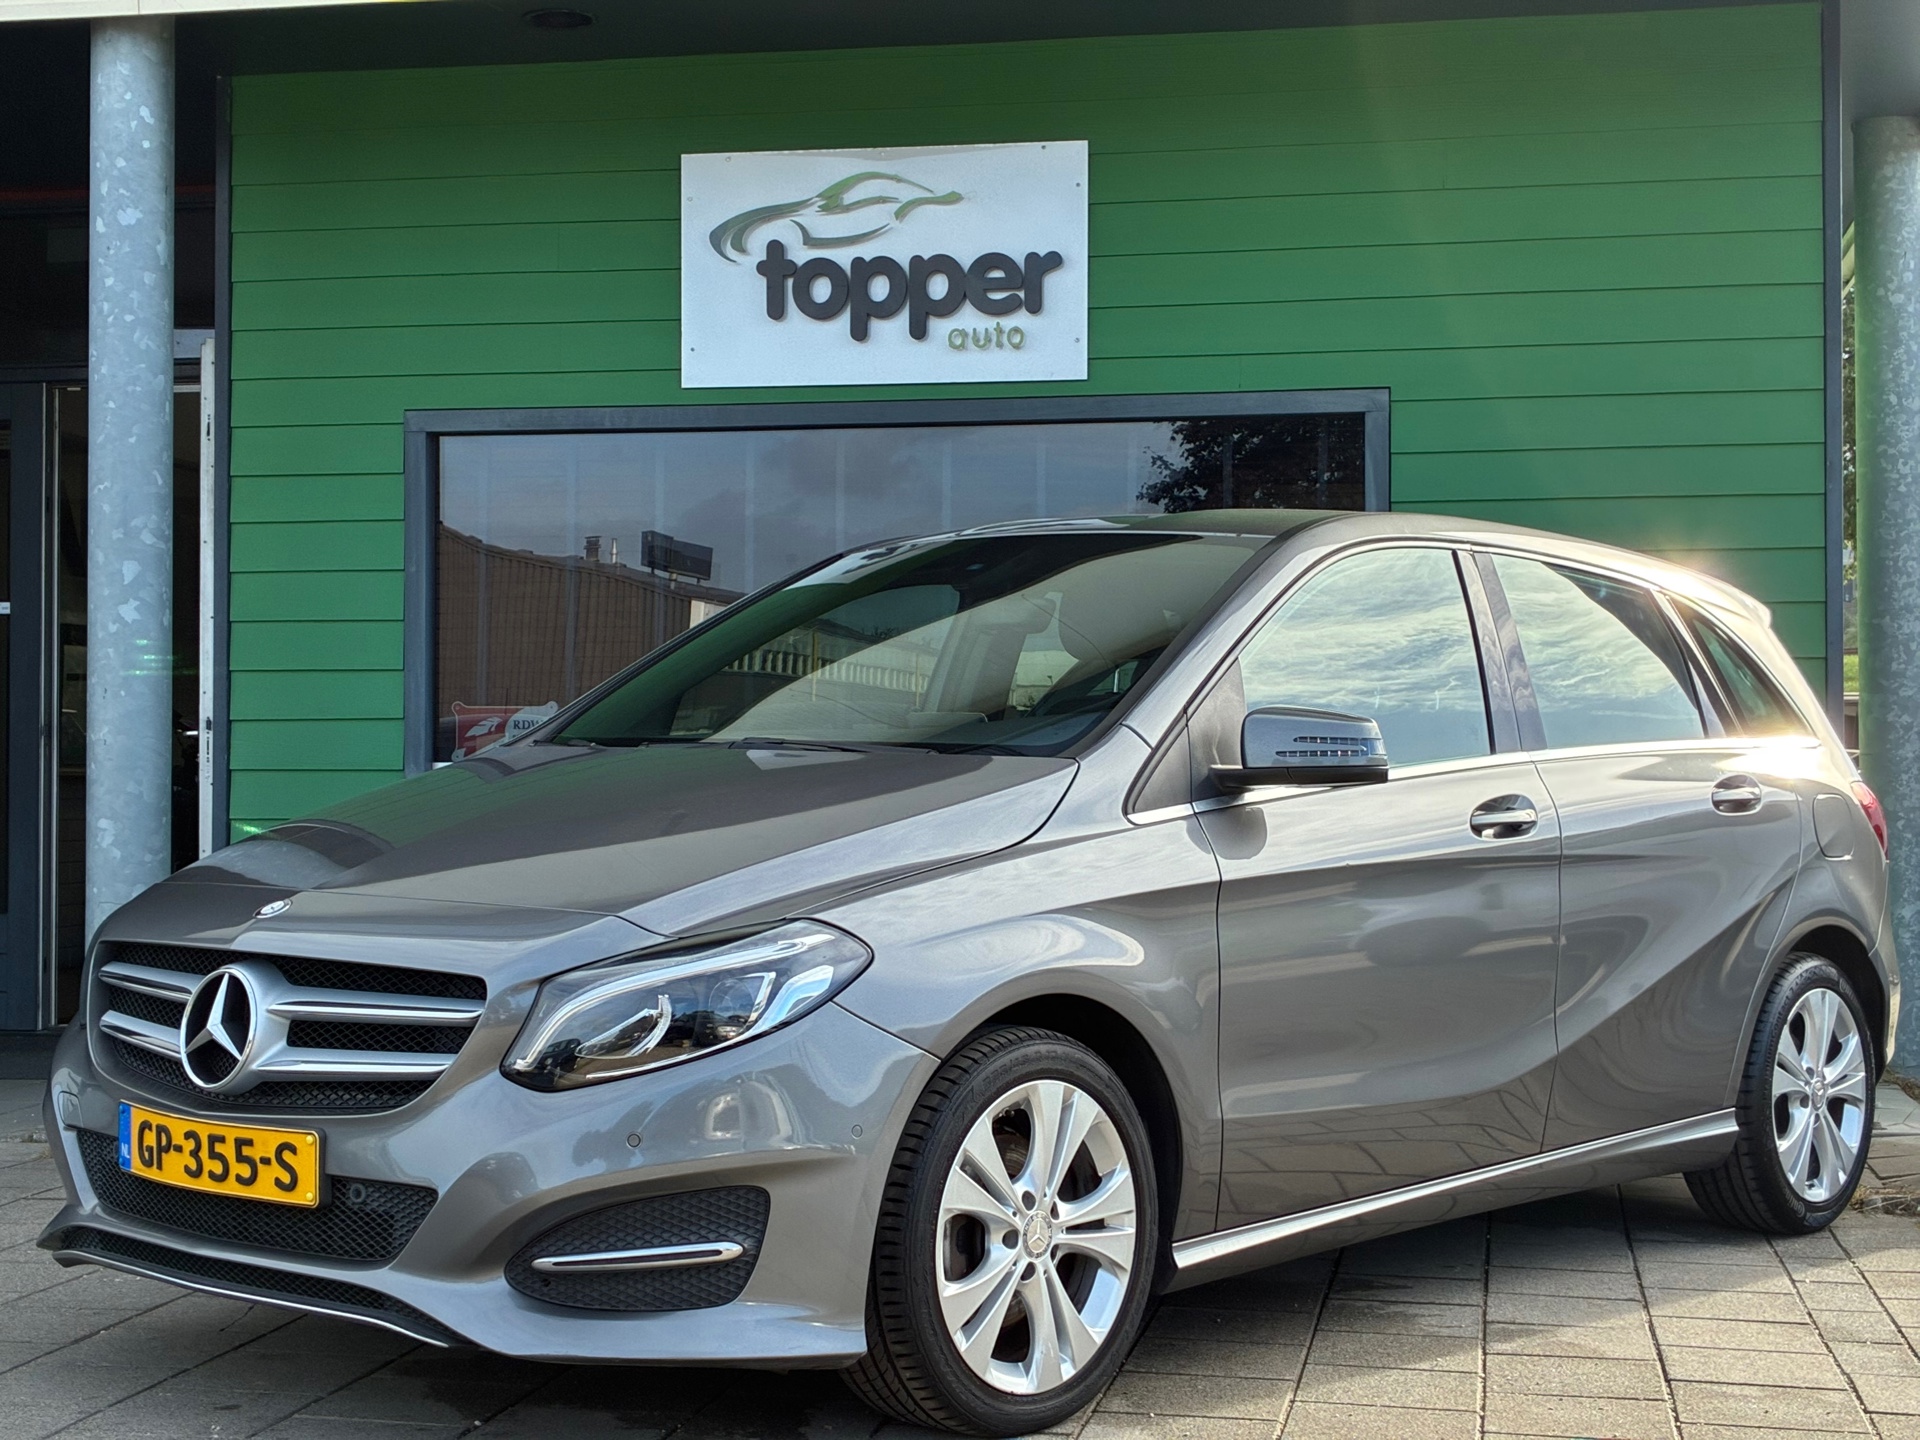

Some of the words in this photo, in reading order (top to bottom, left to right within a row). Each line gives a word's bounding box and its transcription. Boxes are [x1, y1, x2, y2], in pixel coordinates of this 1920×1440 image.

[756, 239, 1063, 342] topper
[947, 321, 1025, 350] auto
[121, 1142, 130, 1158] NL
[137, 1119, 298, 1192] GP-355-S
